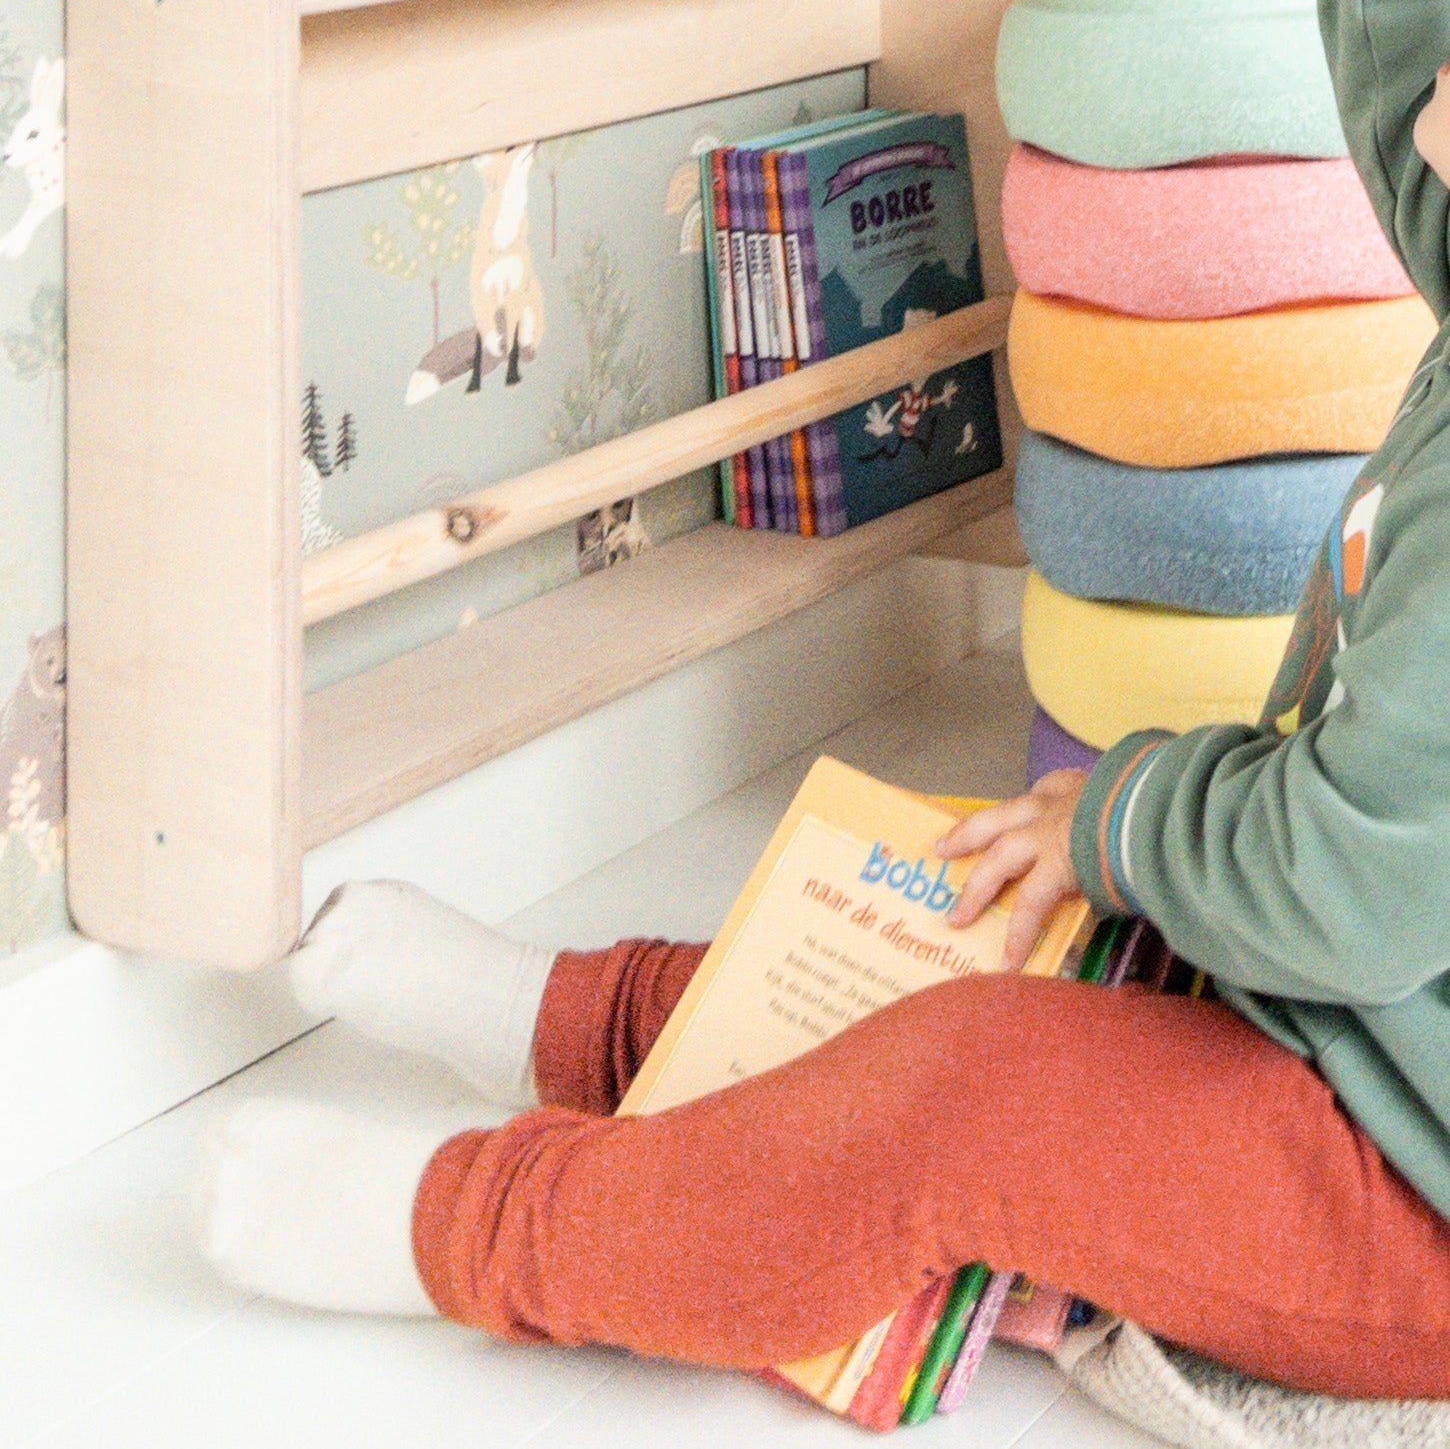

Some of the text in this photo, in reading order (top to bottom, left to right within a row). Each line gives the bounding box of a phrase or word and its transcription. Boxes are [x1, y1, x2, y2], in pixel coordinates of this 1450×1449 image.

[850, 180, 936, 234] BORRE
[801, 877, 853, 914] naar
[849, 901, 879, 930] de
